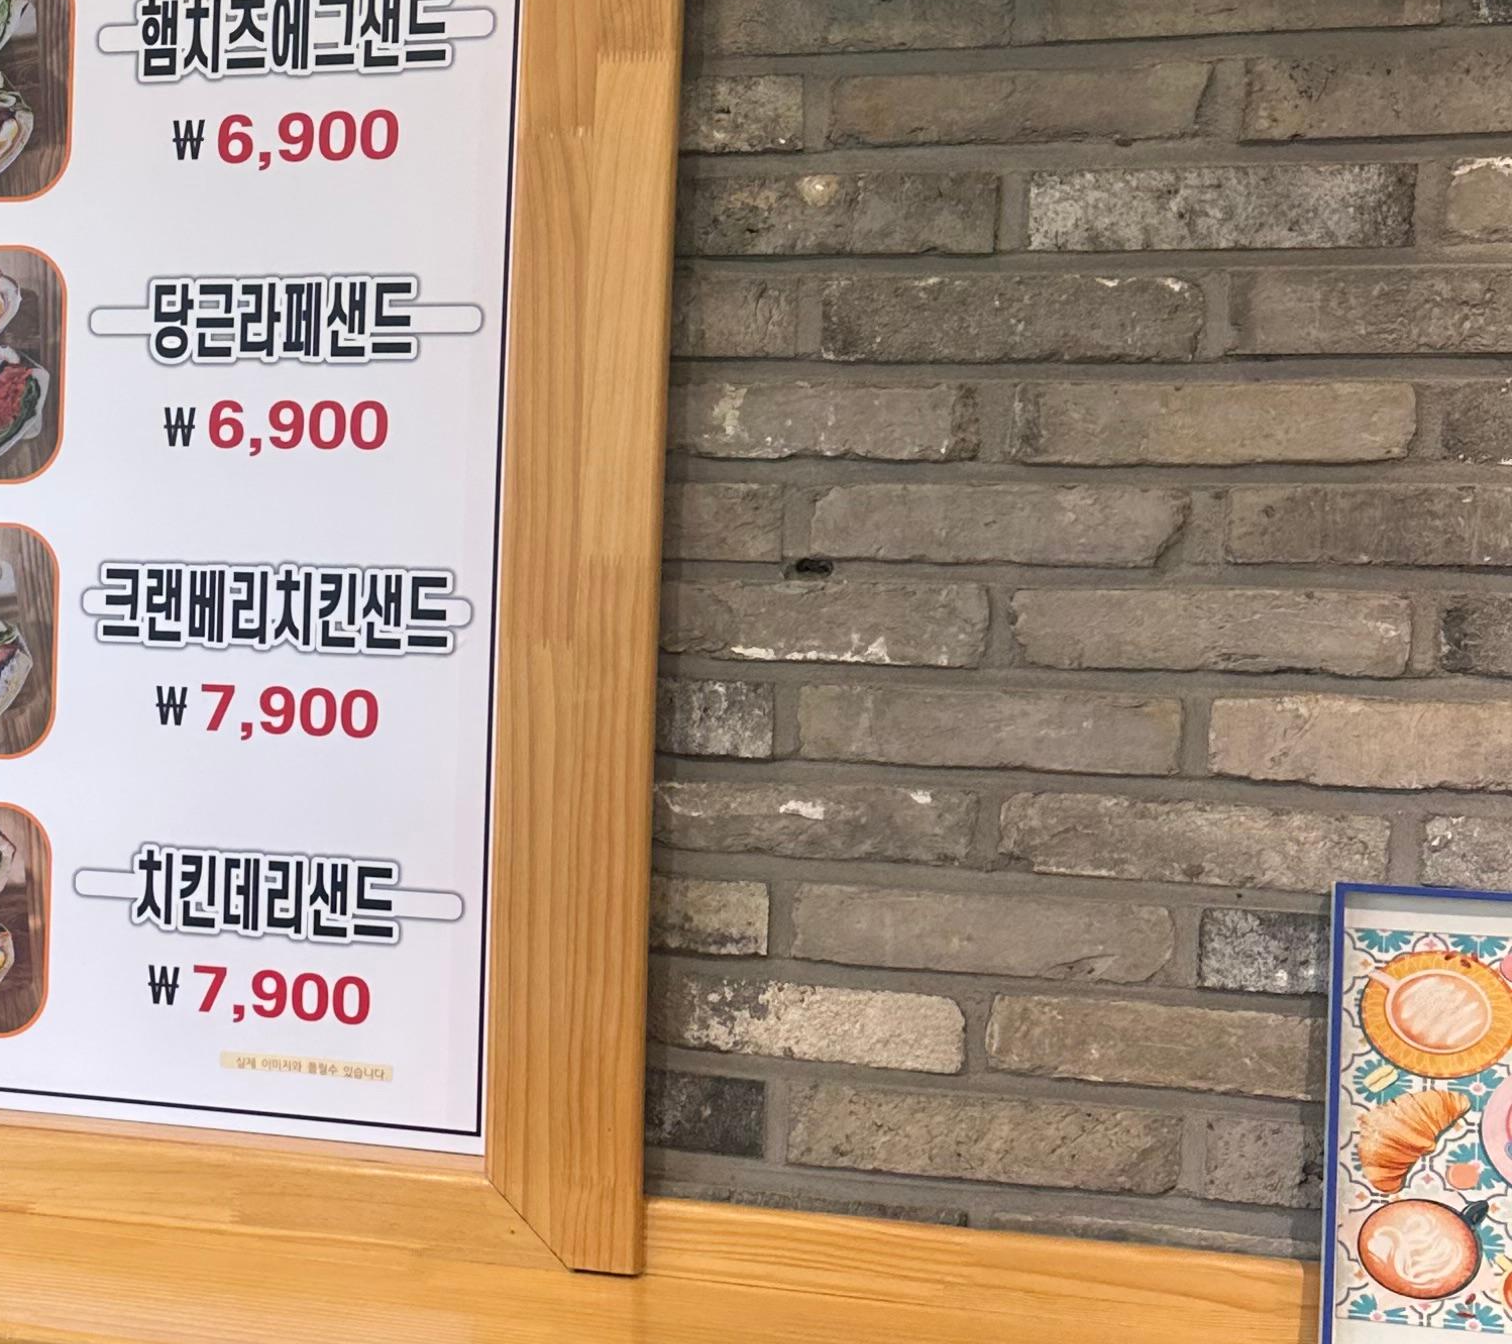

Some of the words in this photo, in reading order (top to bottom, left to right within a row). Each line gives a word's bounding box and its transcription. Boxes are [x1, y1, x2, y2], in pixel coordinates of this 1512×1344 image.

[153, 281, 412, 359] 당근라페샌드
[98, 568, 451, 650] 크랜베리치킨샌드
[136, 849, 395, 939] 치킨데리샌드
[261, 1058, 302, 1072] 이미지와
[344, 1065, 385, 1081] 있습니다
